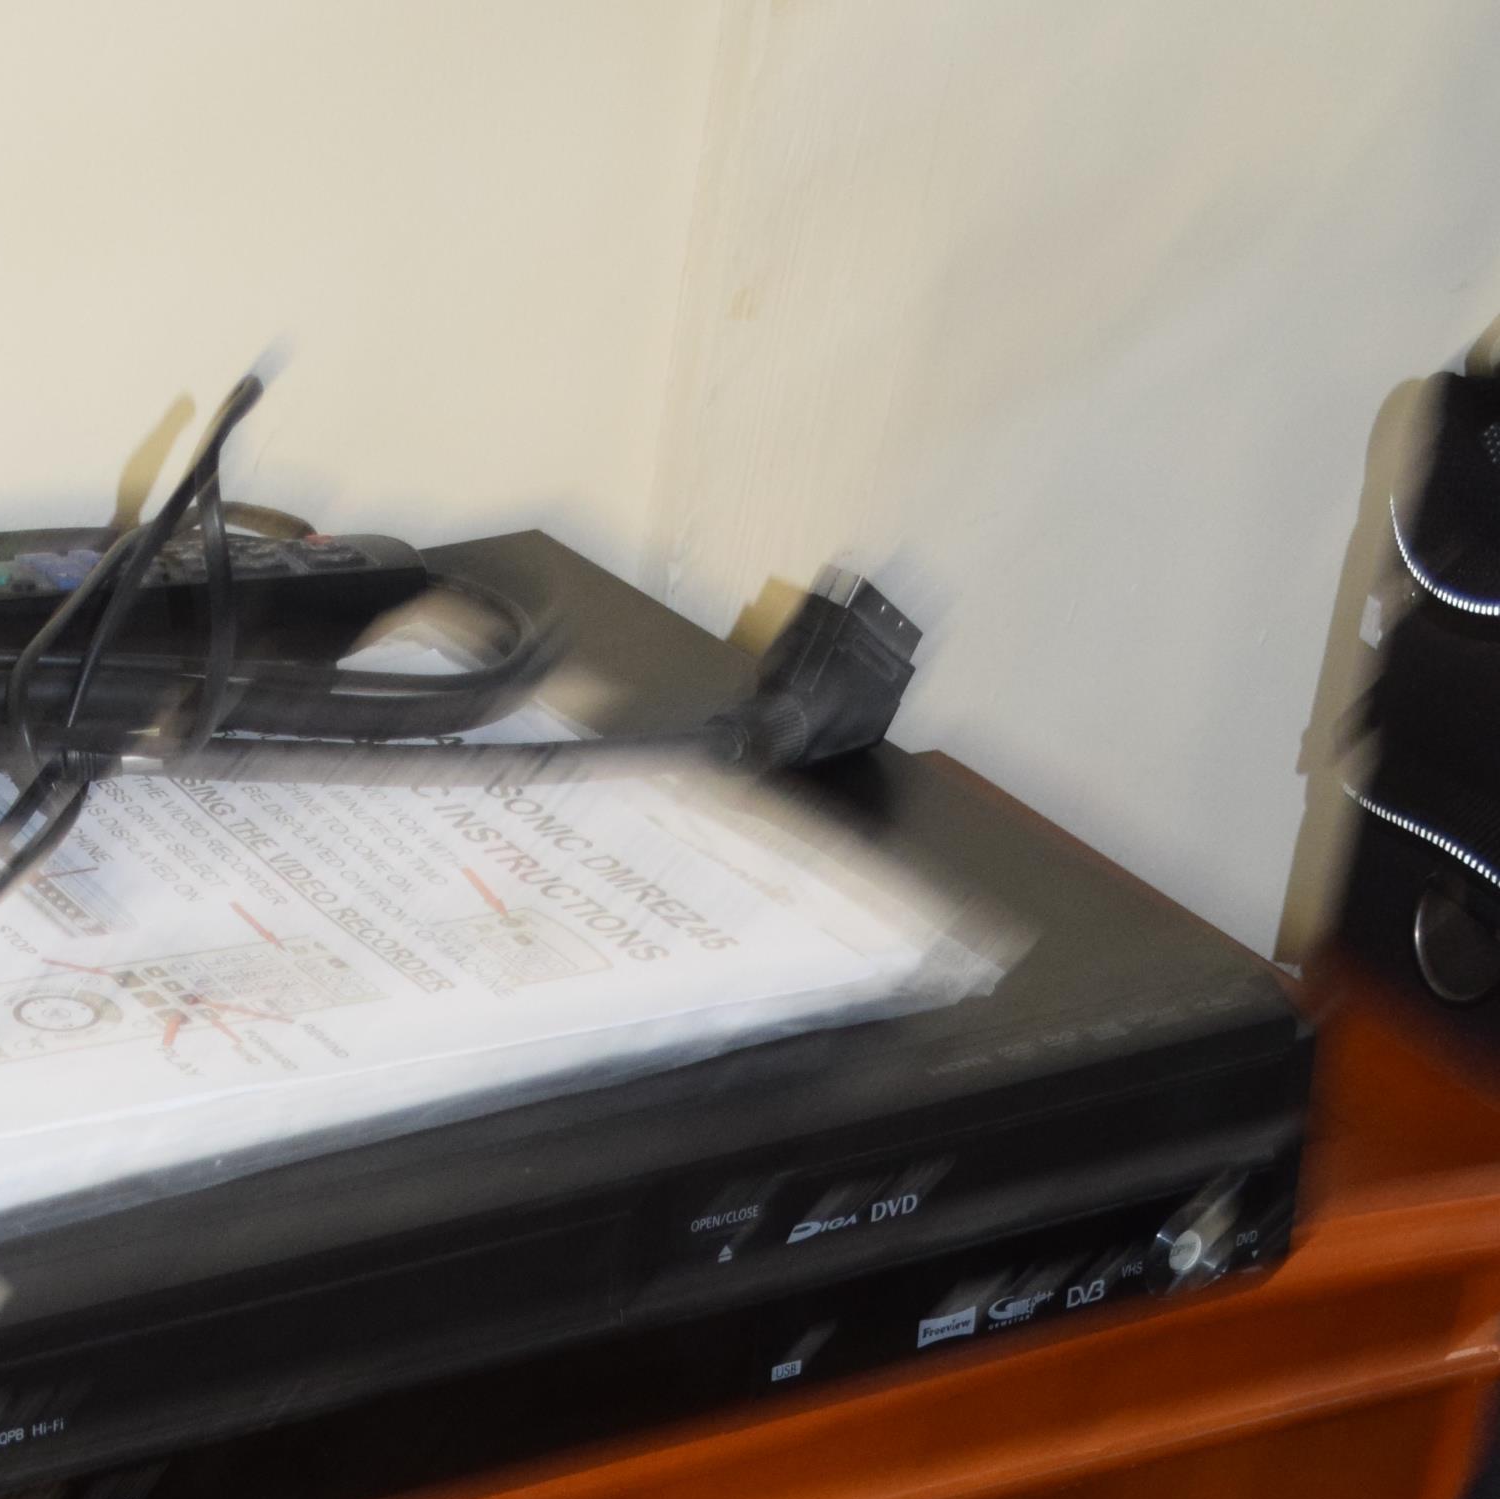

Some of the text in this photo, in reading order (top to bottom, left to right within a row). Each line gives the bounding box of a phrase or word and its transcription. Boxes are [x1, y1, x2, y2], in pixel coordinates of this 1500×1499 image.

[316, 815, 353, 834] TO
[477, 779, 598, 853] SONIC
[95, 817, 183, 882] DISPLAYED
[120, 805, 179, 841] DRIVE
[161, 842, 232, 889] SELECT
[128, 776, 292, 906] THE VIDEO RECORDER
[237, 784, 273, 802] BE
[258, 803, 351, 868] DISPLAYED
[336, 869, 374, 889] ON
[173, 775, 243, 816] SING
[222, 817, 280, 850] THE
[260, 851, 347, 905] VIDEO
[326, 906, 459, 992] RECORDER
[431, 802, 674, 963] INSTRUCTIONS
[690, 1204, 759, 1232] OPEN/CLOSE
[871, 1194, 918, 1223] DVD
[1236, 1230, 1258, 1247] DVD
[1121, 1262, 1143, 1278] VHS
[1066, 1279, 1105, 1309] DVB
[922, 1318, 971, 1339] Freeview
[775, 1362, 797, 1379] USB
[32, 1418, 65, 1437] Hi-Fi
